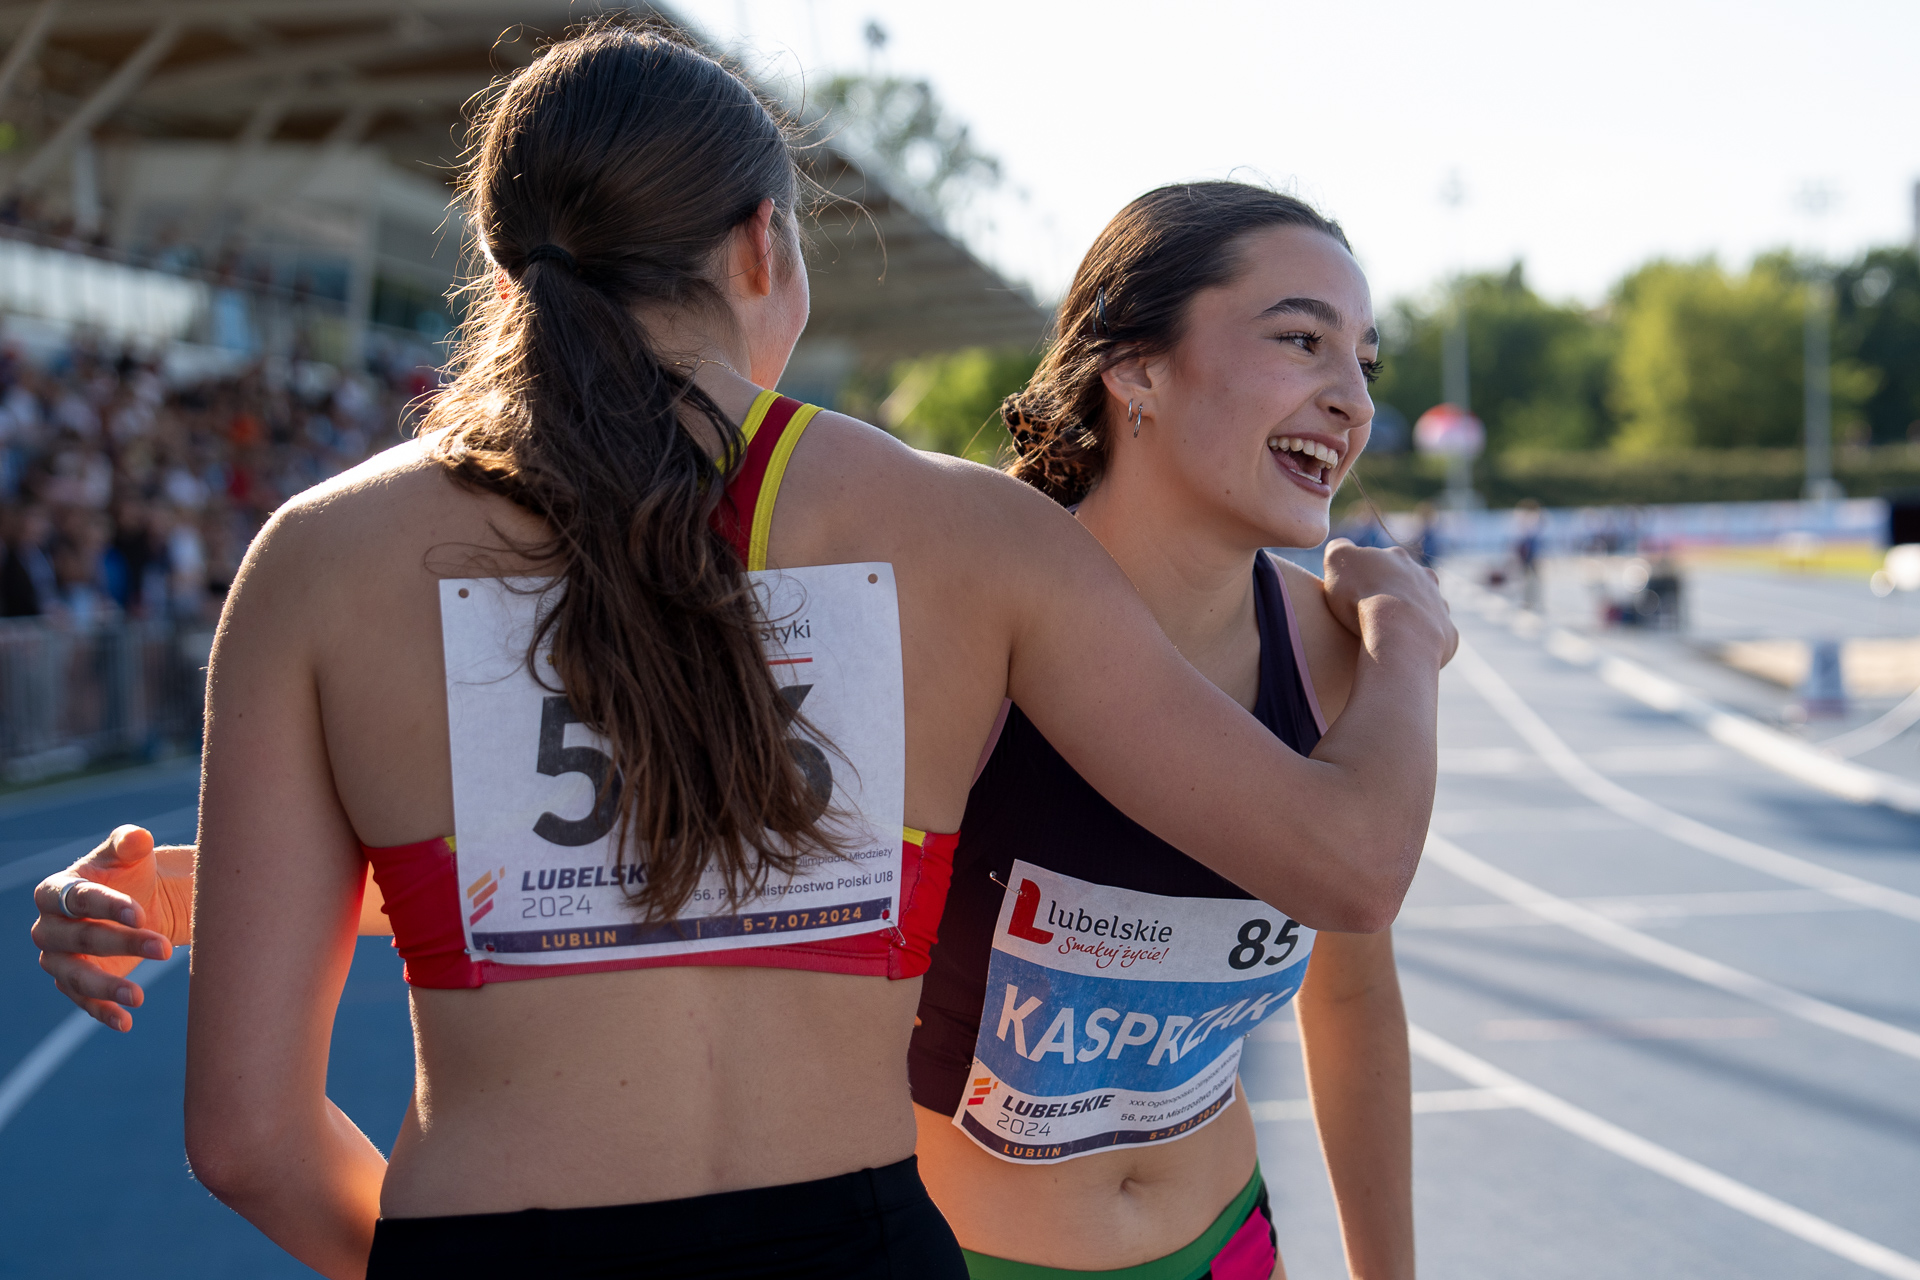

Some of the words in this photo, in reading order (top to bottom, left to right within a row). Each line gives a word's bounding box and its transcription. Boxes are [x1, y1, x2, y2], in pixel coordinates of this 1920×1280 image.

[760, 619, 811, 644] styki
[532, 684, 833, 847] 56
[521, 862, 648, 891] LUBELSK
[693, 888, 714, 901] 56.
[838, 873, 872, 889] Polski
[874, 870, 893, 884] U18
[522, 894, 593, 919] 2024
[1048, 900, 1173, 943] lubelskie
[541, 930, 617, 949] LUBLIN
[743, 906, 862, 932] 5-7.07.2024
[1058, 936, 1124, 969] Smakuj
[1120, 945, 1170, 968] życie!
[1228, 918, 1300, 970] 85
[996, 983, 1293, 1067] KASPRZAK
[1002, 1094, 1115, 1118] LUBELSKIE
[1120, 1113, 1137, 1121] 56.
[1139, 1114, 1164, 1122] PZLA
[996, 1112, 1051, 1137] 2024
[1004, 1144, 1061, 1158] LUBLIN
[1149, 1099, 1221, 1140] 5-7.07.2024
